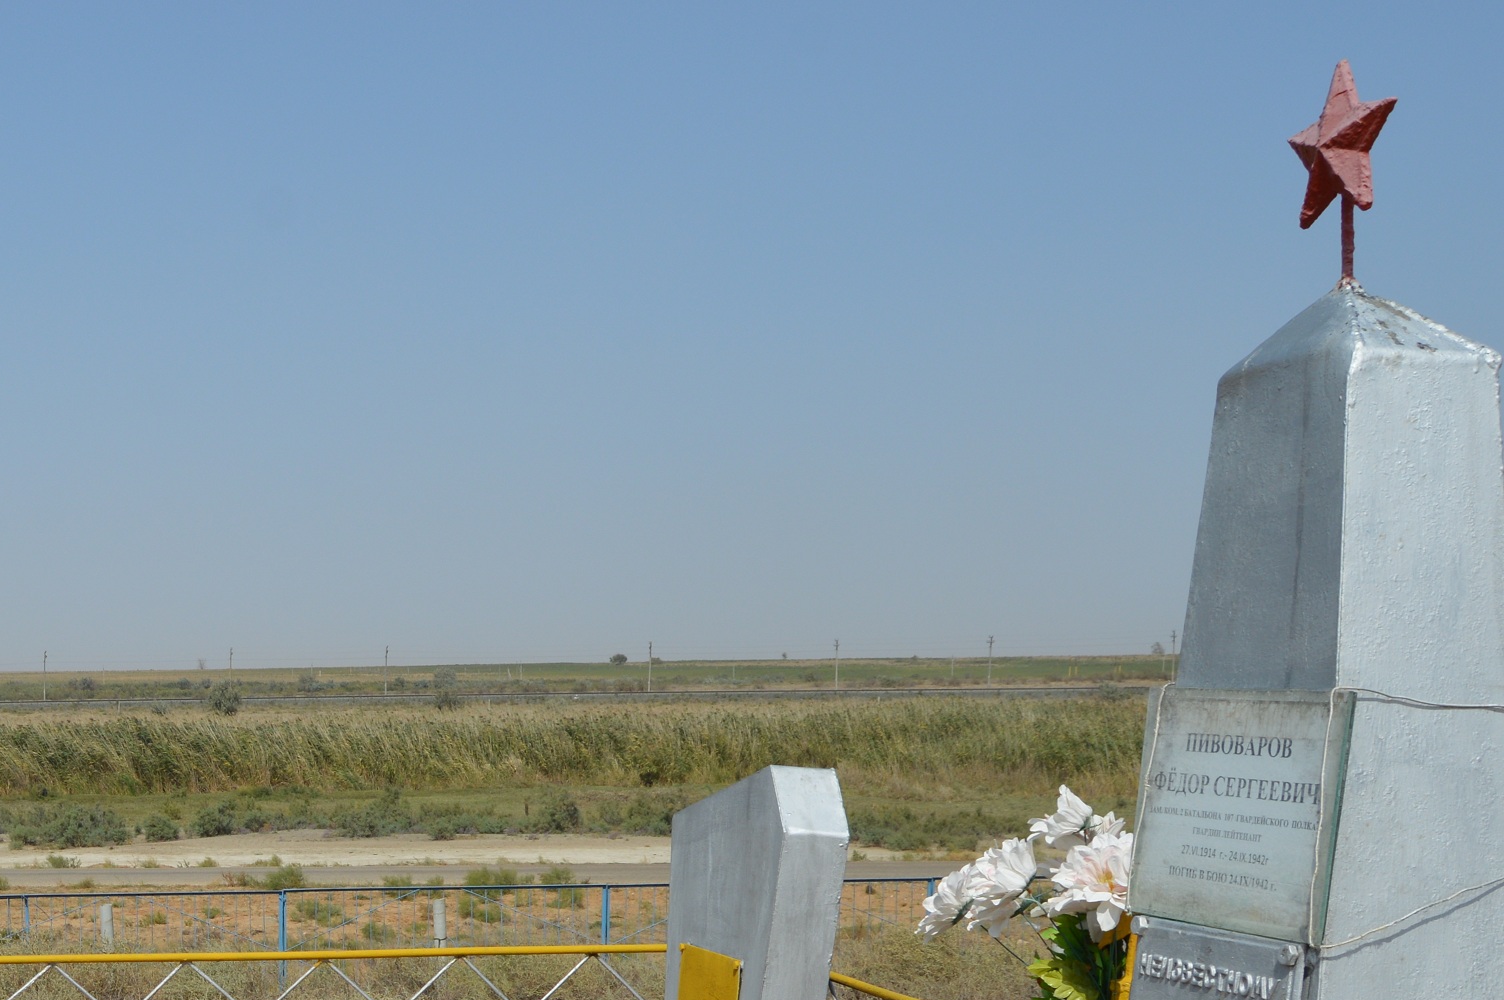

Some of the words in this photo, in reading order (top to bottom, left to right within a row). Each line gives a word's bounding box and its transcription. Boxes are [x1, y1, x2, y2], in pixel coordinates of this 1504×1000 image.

[1185, 732, 1293, 758] ПИВОВАРОВ
[1154, 767, 1210, 797] ФЁДОР
[1213, 775, 1320, 805] СЕРГЕЕВИЧ
[1236, 814, 1289, 828] ГВАРДЕЙСКОГО
[1222, 829, 1262, 842] ЛЕЙТЕНАНТ
[1168, 865, 1197, 879] ПОГИБ
[1199, 869, 1205, 880] В
[1206, 870, 1228, 884] БОЮ
[1139, 952, 1281, 1000] НЕИЗВЕСТНОМУ
